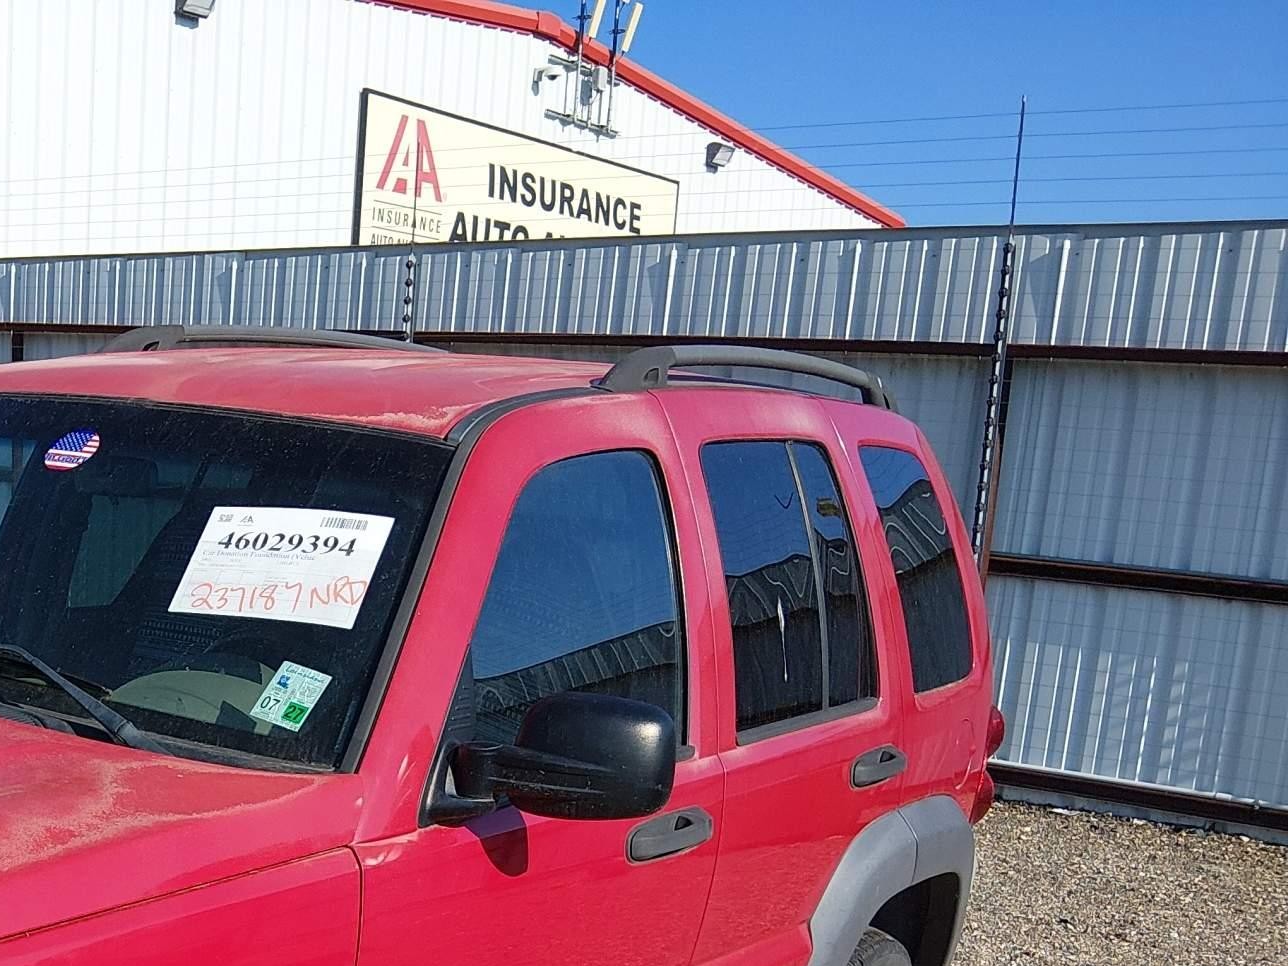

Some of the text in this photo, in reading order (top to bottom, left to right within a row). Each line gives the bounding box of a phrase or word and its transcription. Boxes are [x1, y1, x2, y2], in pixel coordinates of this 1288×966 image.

[488, 163, 642, 235] INSURANCE
[372, 206, 441, 234] INSURANCE
[218, 531, 357, 557] 46029394
[260, 695, 281, 711] 07
[283, 704, 305, 721] 27
